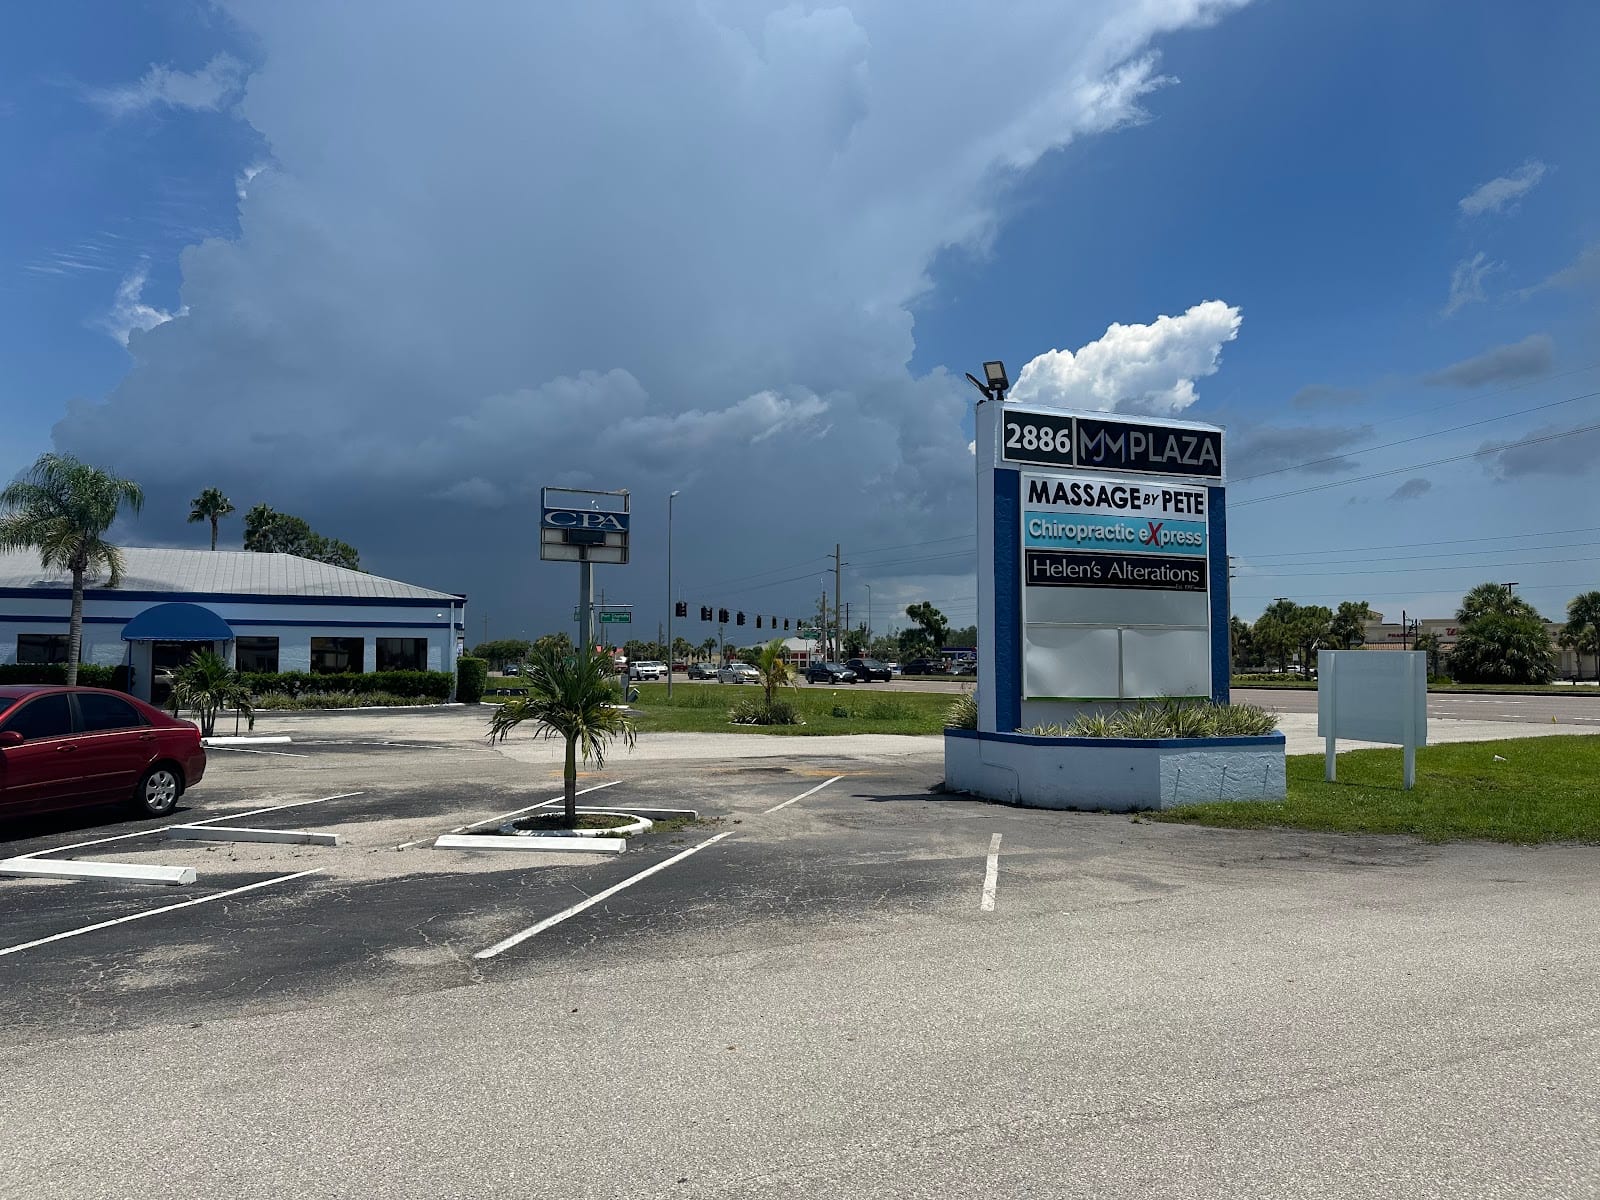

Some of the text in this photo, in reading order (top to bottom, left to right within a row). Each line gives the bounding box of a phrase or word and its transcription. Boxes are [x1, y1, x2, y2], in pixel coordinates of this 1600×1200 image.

[1006, 423, 1071, 454] 2886
[1079, 427, 1219, 467] MJM PLAZA
[1028, 480, 1204, 515] MASSAGE BY PETE
[544, 511, 625, 529] CPA
[1028, 519, 1203, 547] Chiropractic eXpress
[1033, 559, 1200, 583] Helen's Alterations
